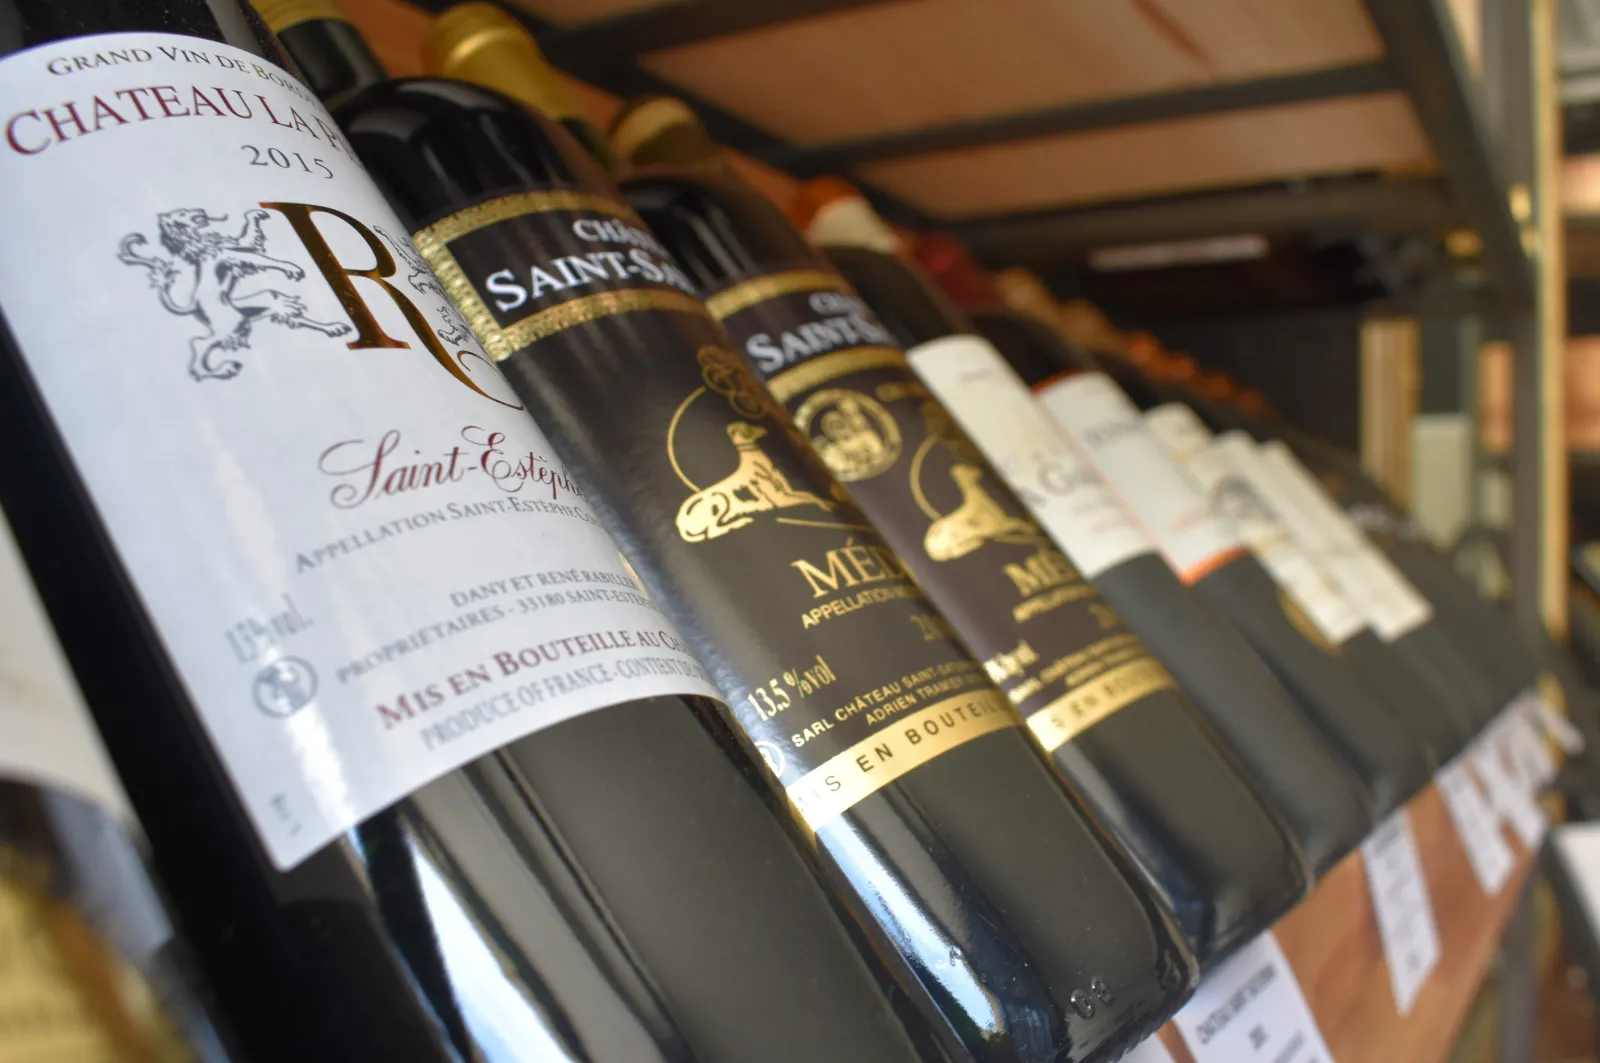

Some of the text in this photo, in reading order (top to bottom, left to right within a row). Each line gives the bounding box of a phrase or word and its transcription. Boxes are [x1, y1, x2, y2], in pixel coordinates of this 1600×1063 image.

[47, 47, 152, 77] GRAND
[156, 46, 211, 65] VIN
[215, 55, 251, 74] DE
[5, 84, 253, 157] CHATEAU
[253, 93, 322, 141] LA
[240, 143, 335, 180] 2015
[295, 508, 447, 573] APPELLATION
[449, 579, 509, 608] DANY
[509, 574, 535, 591] ET
[535, 567, 583, 587] RENÉ
[516, 591, 566, 615] 33180
[375, 682, 446, 731] MIS
[447, 663, 493, 697] EN
[493, 629, 637, 678] BOUTEILLE
[636, 629, 661, 648] AU
[420, 690, 520, 752] PRODUCE
[516, 680, 546, 707] OF
[542, 661, 614, 698] FRANCE
[865, 693, 917, 726] ADRIEN
[791, 718, 835, 748] SARL
[855, 742, 894, 773] EN
